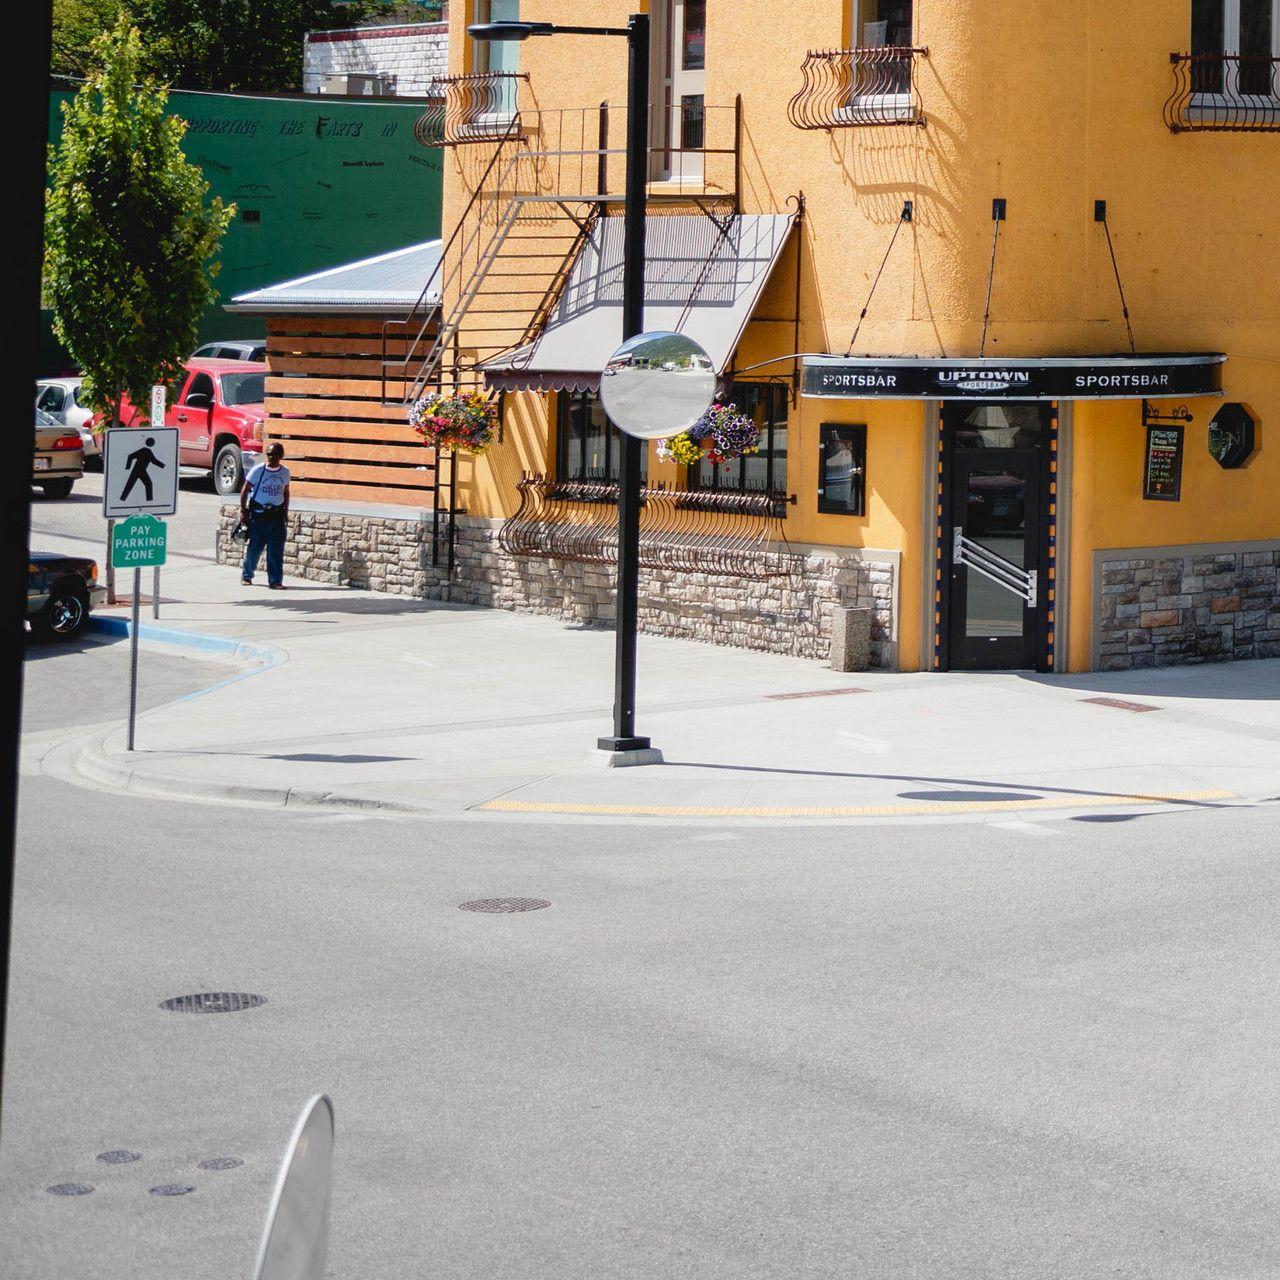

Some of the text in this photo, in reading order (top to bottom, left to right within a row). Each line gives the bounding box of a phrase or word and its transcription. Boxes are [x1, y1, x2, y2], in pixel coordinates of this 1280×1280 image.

[188, 119, 258, 137] PPORTING
[278, 120, 304, 136] THE
[823, 374, 897, 387] SPORTSBAR
[938, 371, 1029, 381] UPTOWN
[1075, 374, 1168, 387] SPORTSBAR
[130, 525, 150, 535] PAY
[115, 536, 165, 548] PARKING
[124, 550, 154, 560] ZONE
